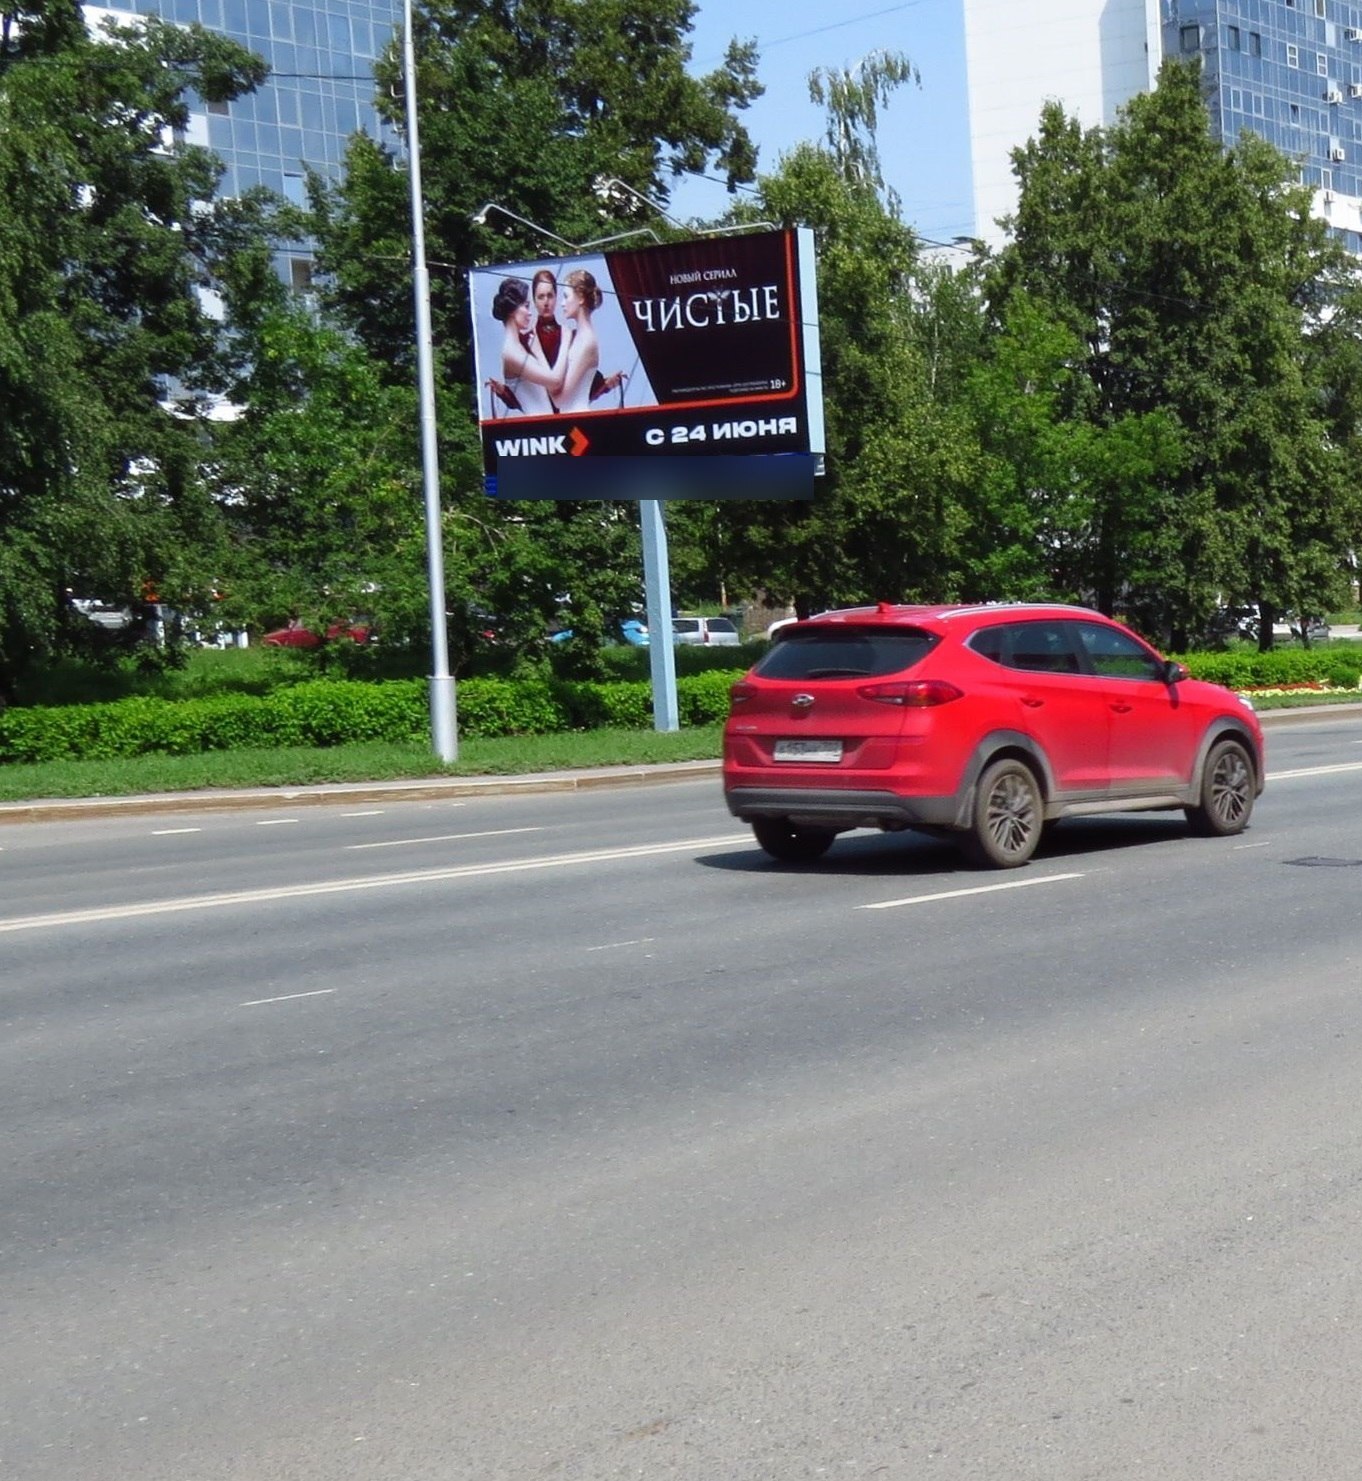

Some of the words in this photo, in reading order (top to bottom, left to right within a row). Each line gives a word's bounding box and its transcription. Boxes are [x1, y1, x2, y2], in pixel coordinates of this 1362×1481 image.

[669, 270, 701, 285] НОВЫЙ
[703, 268, 737, 281] СЕРИАЛ
[632, 285, 780, 332] ЧИСТЫЕ
[770, 379, 787, 390] 18+
[645, 428, 665, 446] С
[671, 425, 706, 444] 24
[712, 416, 798, 440] ИЮНЯ
[495, 435, 567, 457] WINK
